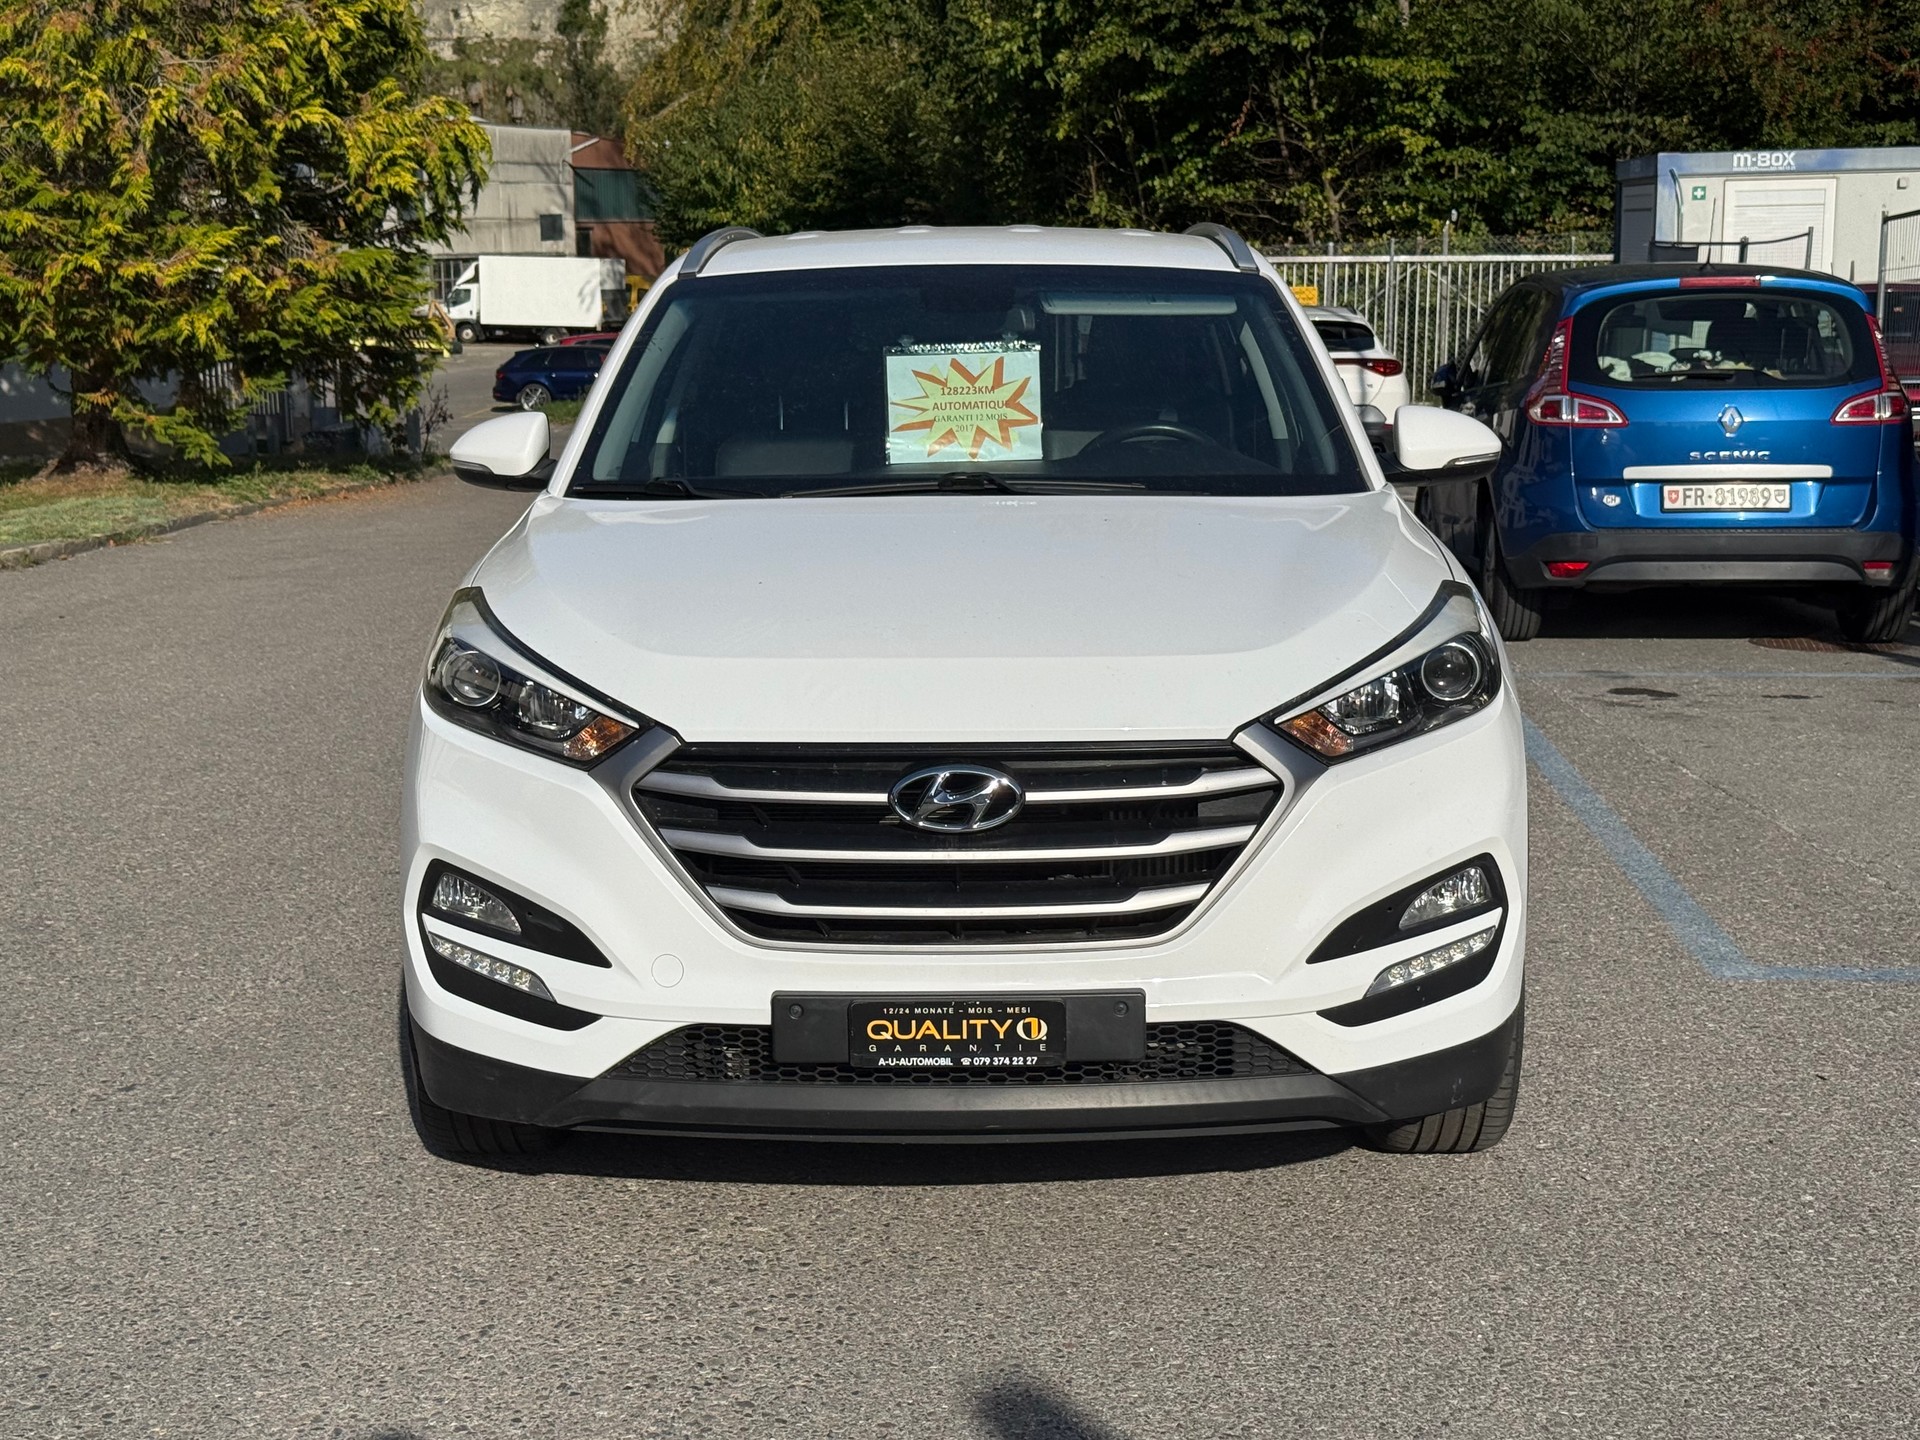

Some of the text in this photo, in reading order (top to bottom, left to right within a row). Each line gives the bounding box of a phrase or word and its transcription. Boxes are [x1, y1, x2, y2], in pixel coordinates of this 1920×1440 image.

[941, 386, 995, 396] 128223KM
[934, 412, 1008, 423] GARANTI 12 MOIS
[955, 424, 974, 433] 2017
[1689, 450, 1771, 461] SCENIC
[1605, 494, 1617, 504] CH
[1006, 1006, 1031, 1014] MESI
[866, 1019, 1013, 1040] QUALITY
[868, 1043, 1046, 1052] GARANTIE
[878, 1056, 1038, 1066] A-U-AUTOMOBIL 079 374 22 27
